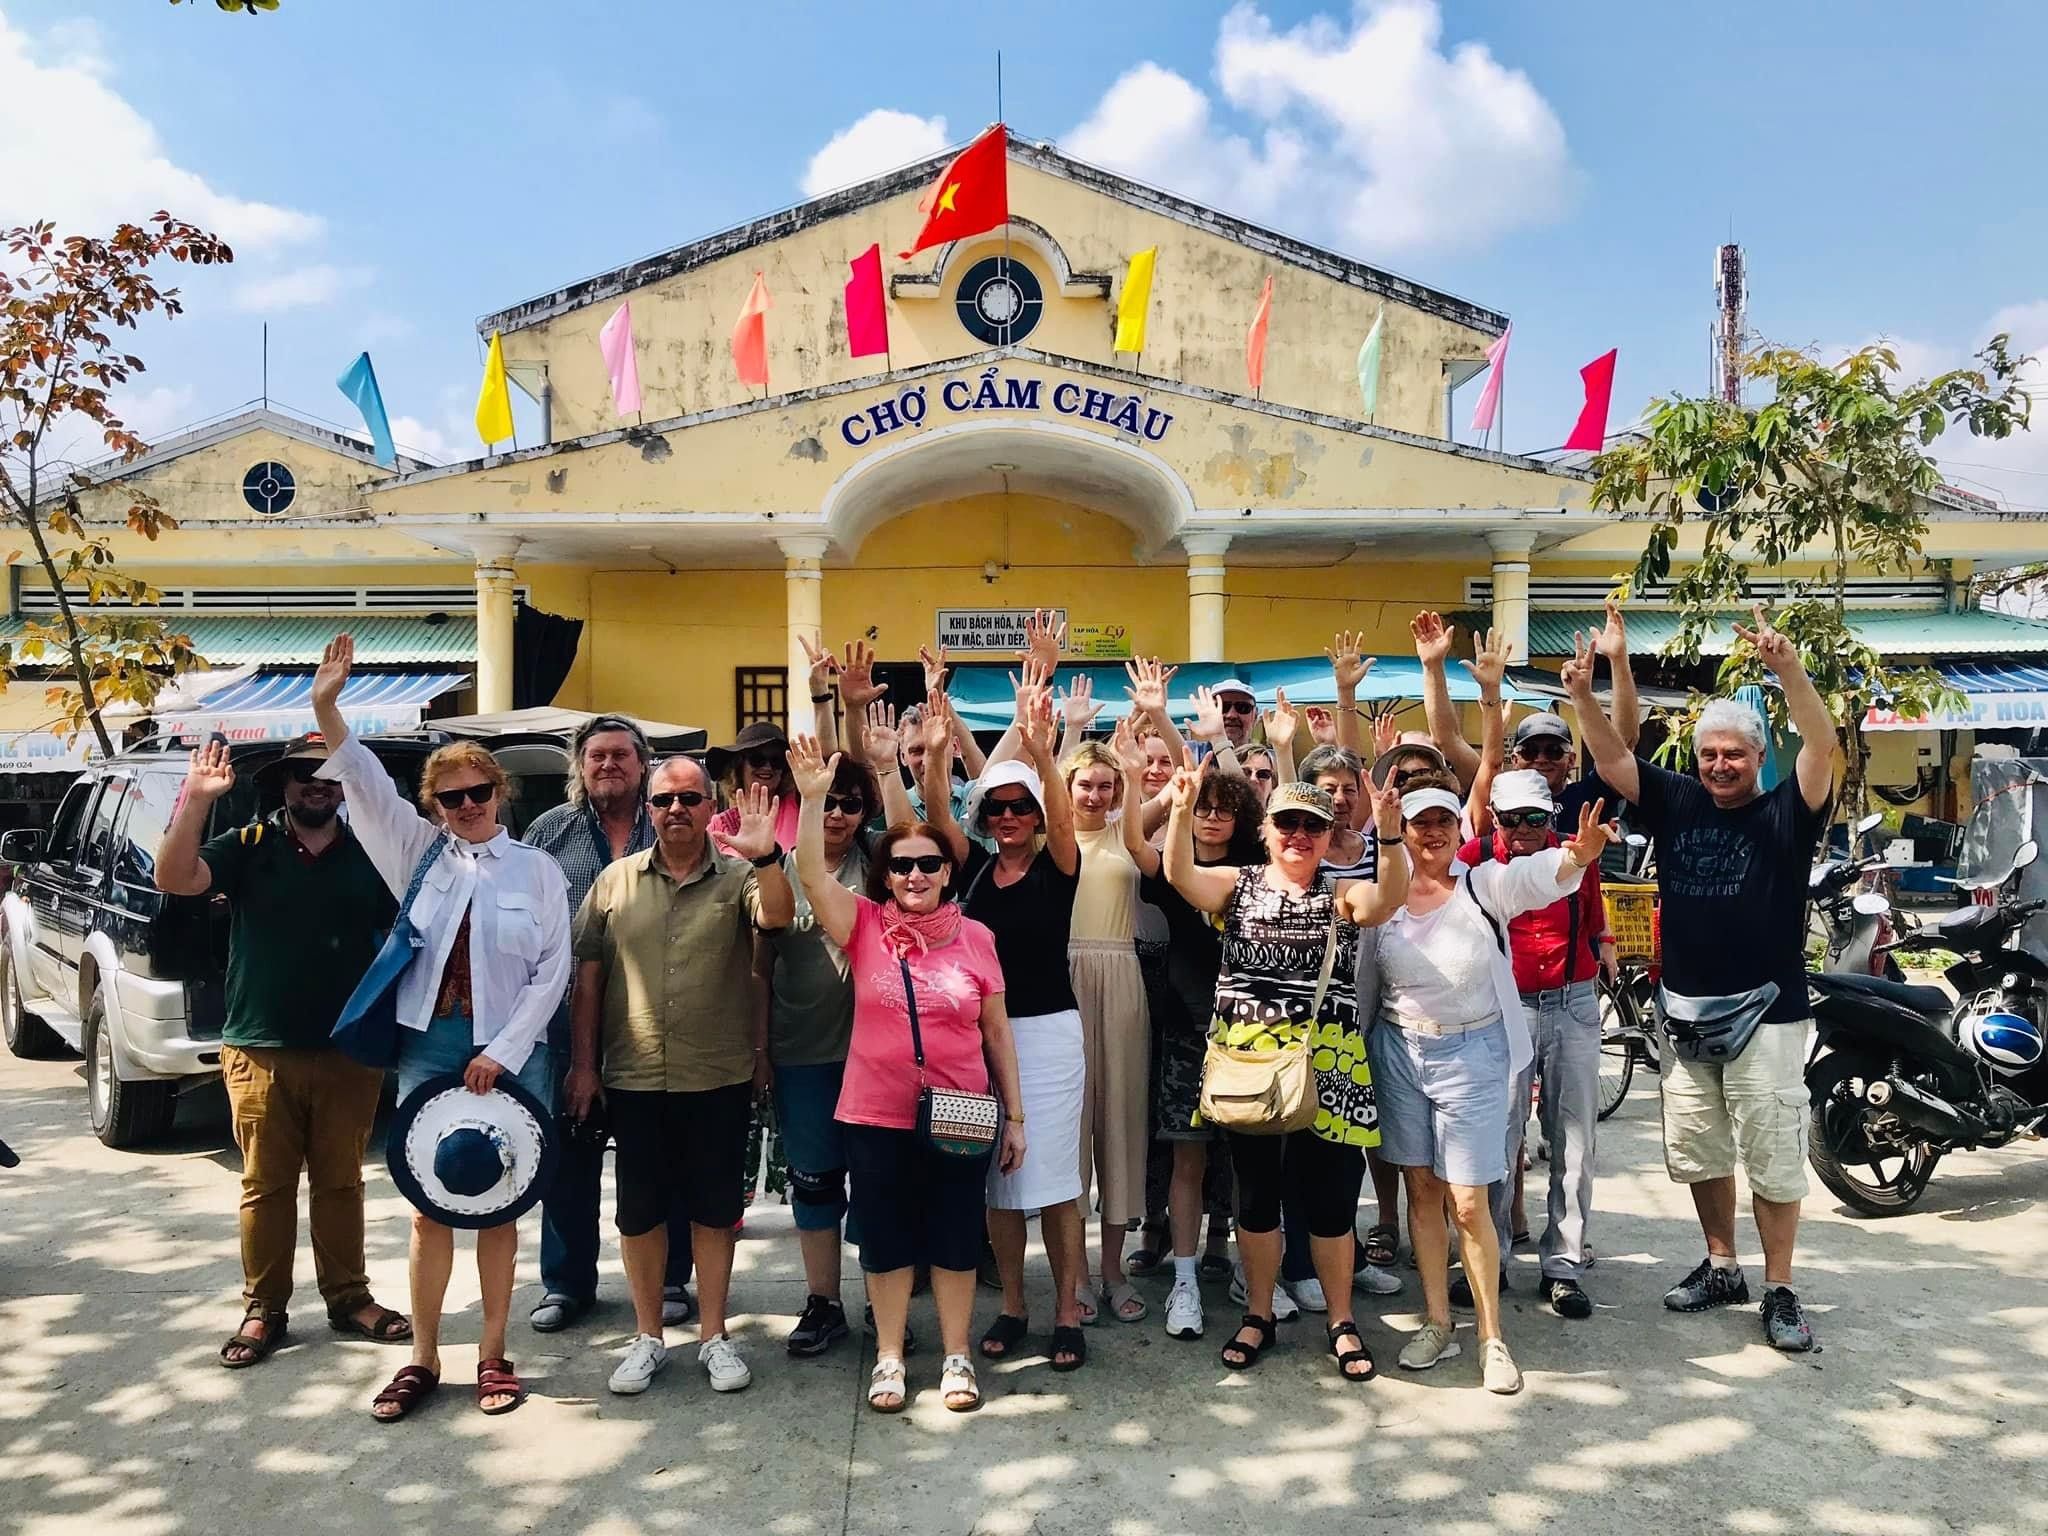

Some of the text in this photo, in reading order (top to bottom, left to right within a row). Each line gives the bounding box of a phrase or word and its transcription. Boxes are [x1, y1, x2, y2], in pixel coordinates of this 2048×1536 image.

[841, 367, 1174, 447] CHỢ CẨM CHÂU
[950, 616, 967, 629] KHU
[970, 614, 992, 629] BÁCH
[994, 615, 1014, 630] HÓA,
[942, 634, 960, 647] MAY
[962, 632, 984, 649] MẶC,
[987, 632, 1005, 647] GIÀY
[1008, 632, 1026, 648] DÉP,
[16, 761, 33, 769] 024
